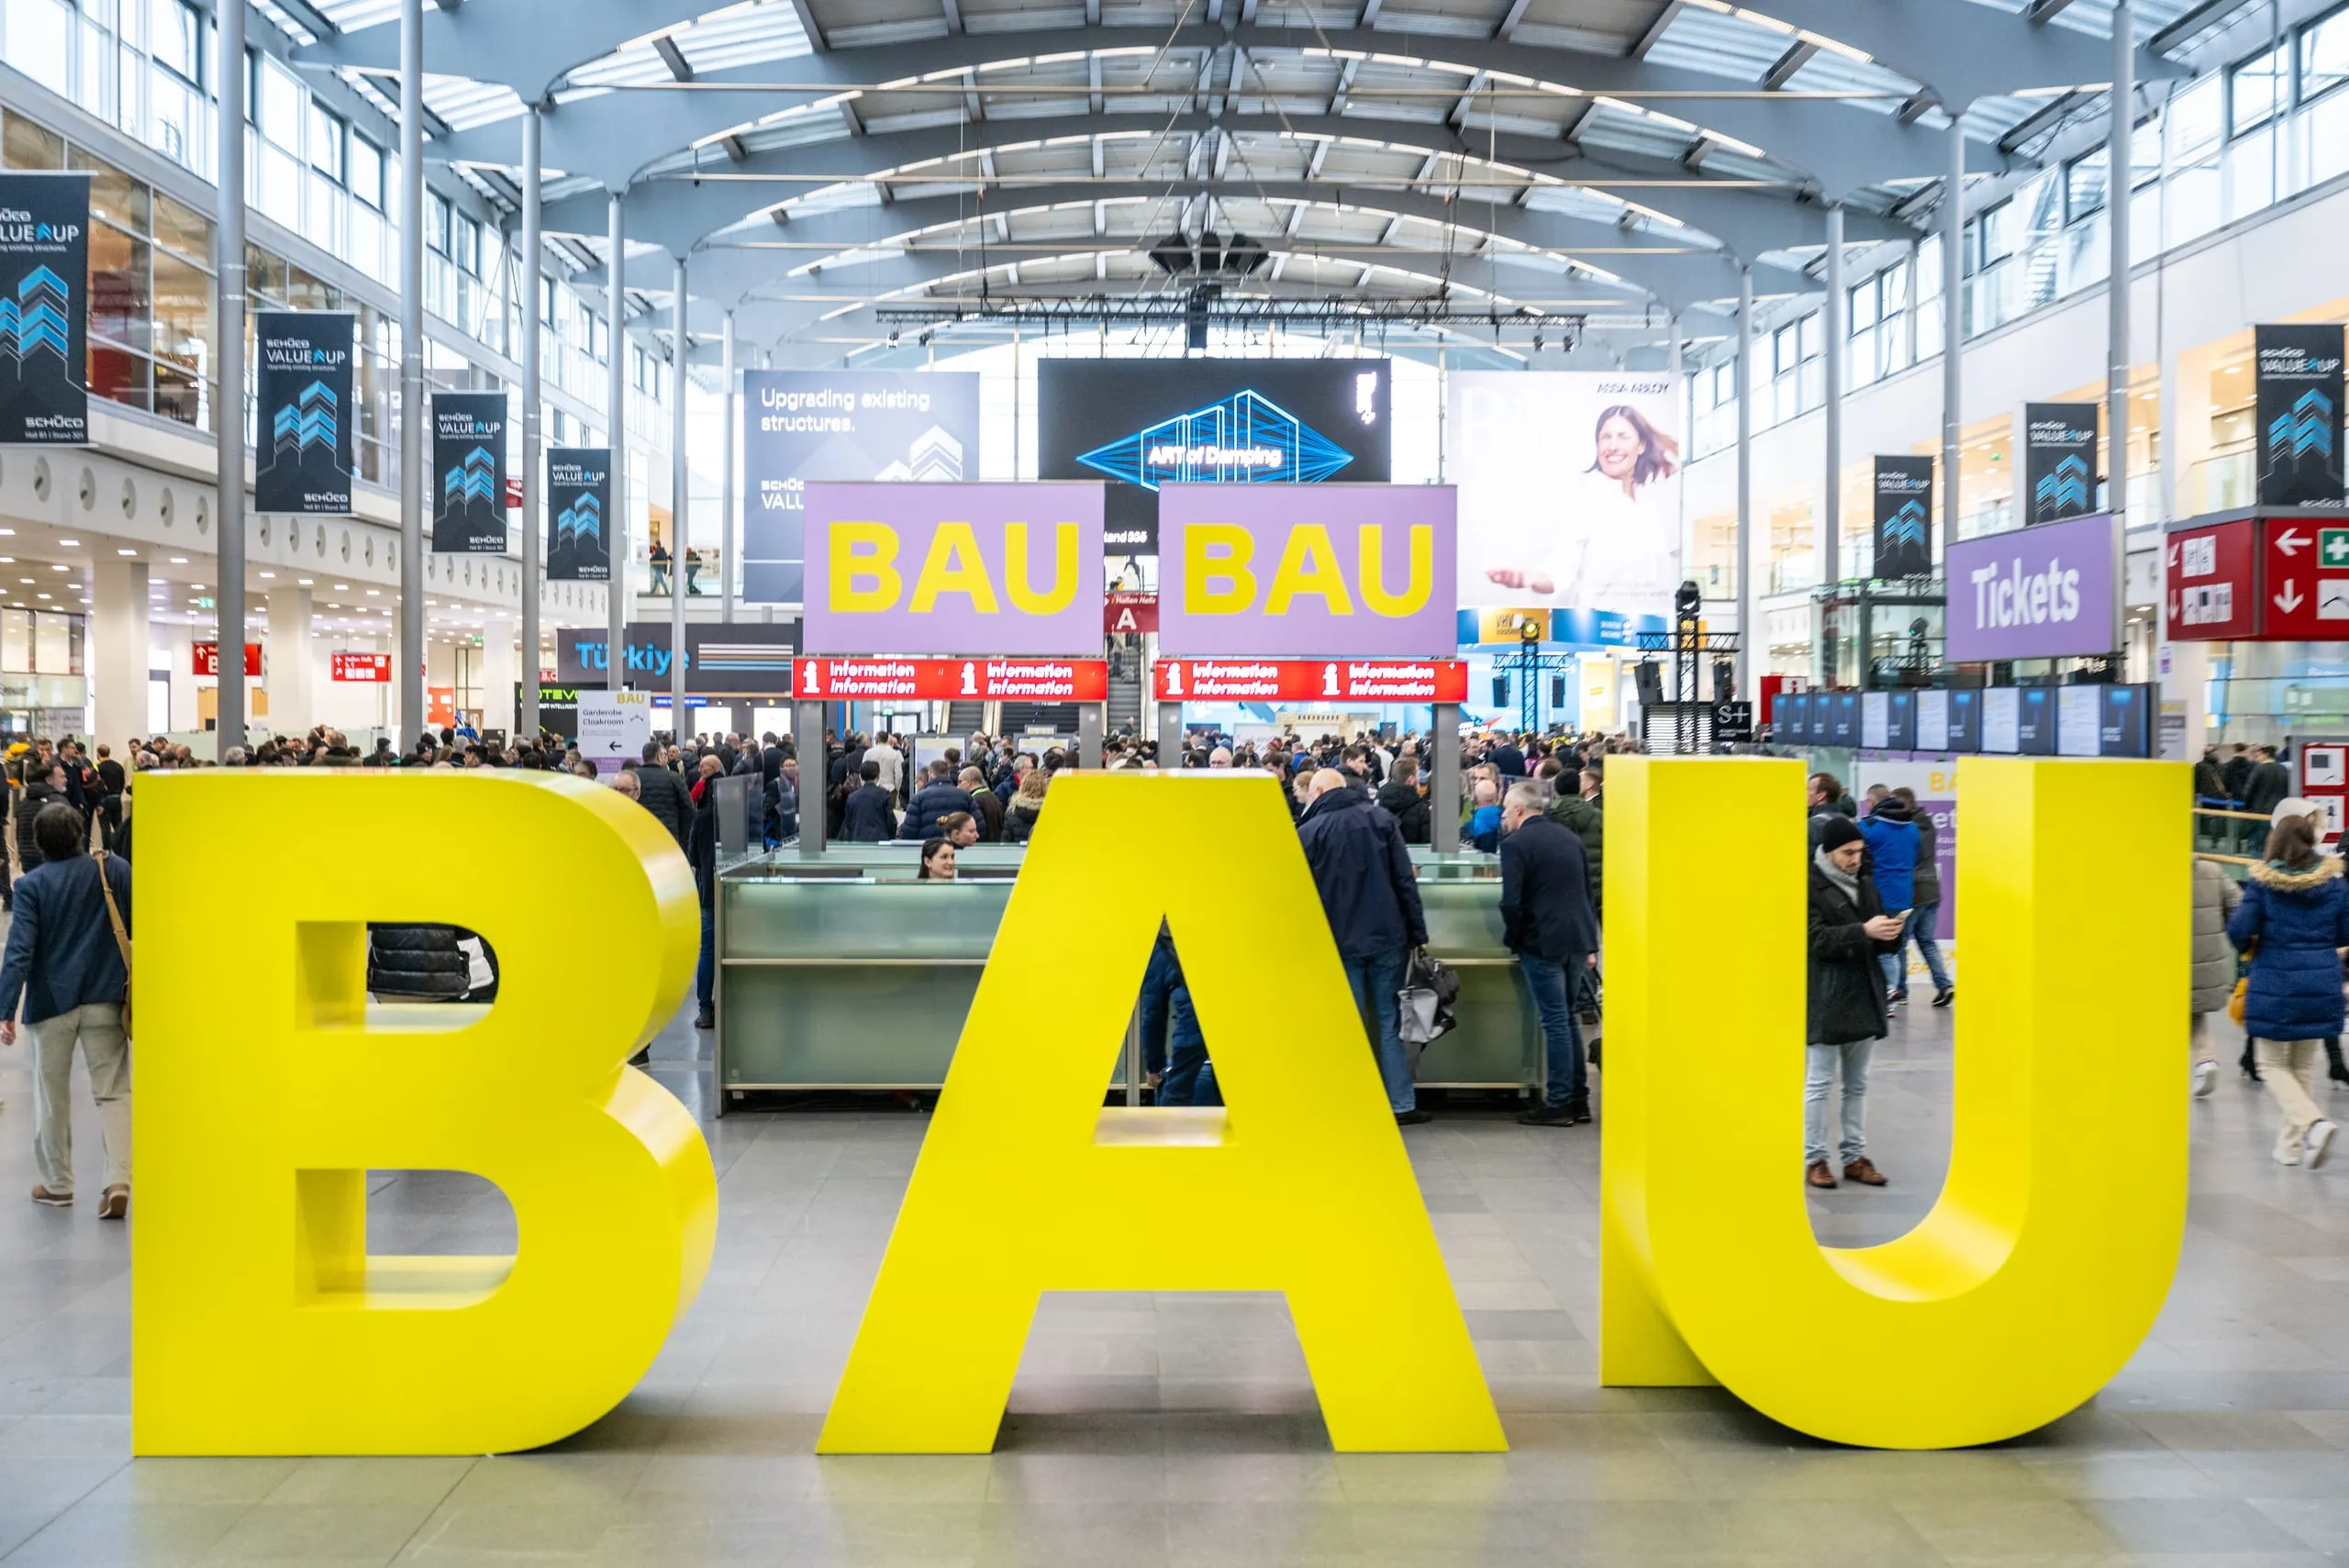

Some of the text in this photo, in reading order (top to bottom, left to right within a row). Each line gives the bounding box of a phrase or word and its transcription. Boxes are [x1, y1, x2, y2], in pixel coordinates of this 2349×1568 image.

[0, 224, 79, 242] LUE UP
[266, 350, 345, 364] VALUE UP
[761, 388, 930, 412] Upgrading existing
[439, 422, 501, 434] VALUE UP
[761, 415, 856, 432] structures.
[1148, 446, 1186, 465] ART
[1206, 445, 1282, 469] Damping
[552, 472, 606, 482] VALUE UP
[1104, 531, 1126, 543] tand
[829, 521, 1080, 617] BAU
[1184, 523, 1434, 618] BAU
[1970, 556, 2081, 630] Tickets
[1116, 607, 1137, 630] A
[575, 641, 691, 676] Tükiy
[829, 660, 916, 677] Information
[987, 661, 1074, 678] Information
[1193, 662, 1278, 678] Information
[1349, 662, 1435, 679] Information
[829, 677, 916, 694] Information
[987, 679, 1074, 695] Information
[1193, 679, 1279, 695] Information
[1349, 680, 1436, 695] Information
[617, 693, 645, 705] BAU
[583, 708, 623, 717] Garderobe
[583, 718, 624, 727] Cloakroom
